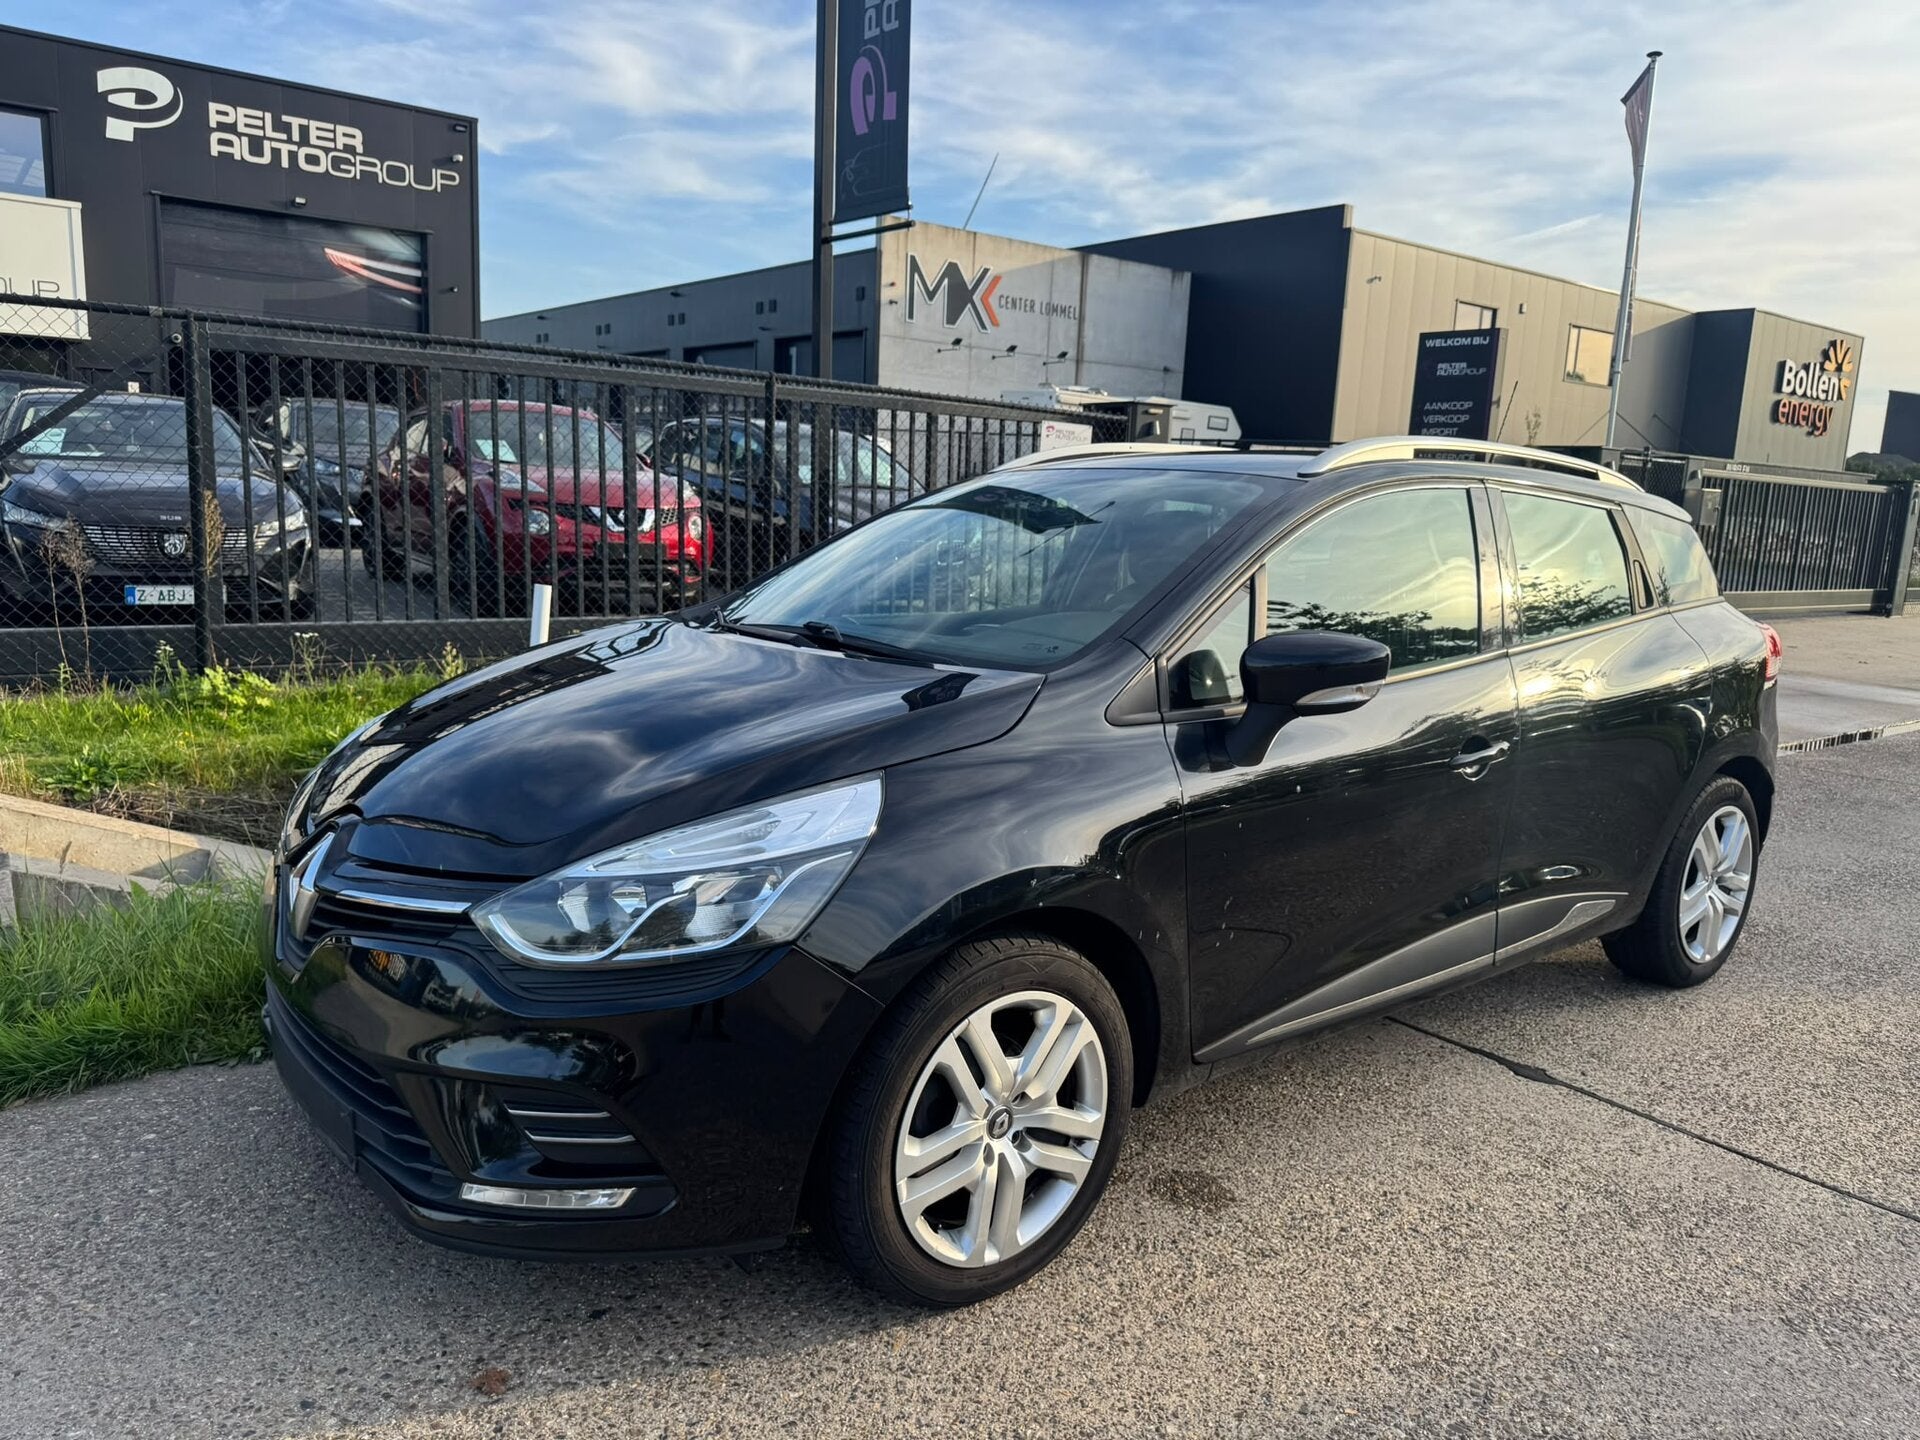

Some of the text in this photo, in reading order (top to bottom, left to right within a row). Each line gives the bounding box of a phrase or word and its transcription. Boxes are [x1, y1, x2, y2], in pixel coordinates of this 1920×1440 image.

[208, 101, 364, 154] PELTER
[210, 131, 460, 193] AUTOGROUP
[998, 294, 1036, 314] CENTER
[1039, 301, 1078, 320] LOMMEL
[1425, 336, 1490, 348] WELKOM BIJ
[1781, 359, 1839, 401] Bollen
[1424, 401, 1474, 410] AANKOOP
[1422, 414, 1470, 423] VERKOOP
[1778, 397, 1833, 437] energy
[1421, 427, 1459, 436] IMPORT
[137, 589, 193, 602] Z-ABJ-
